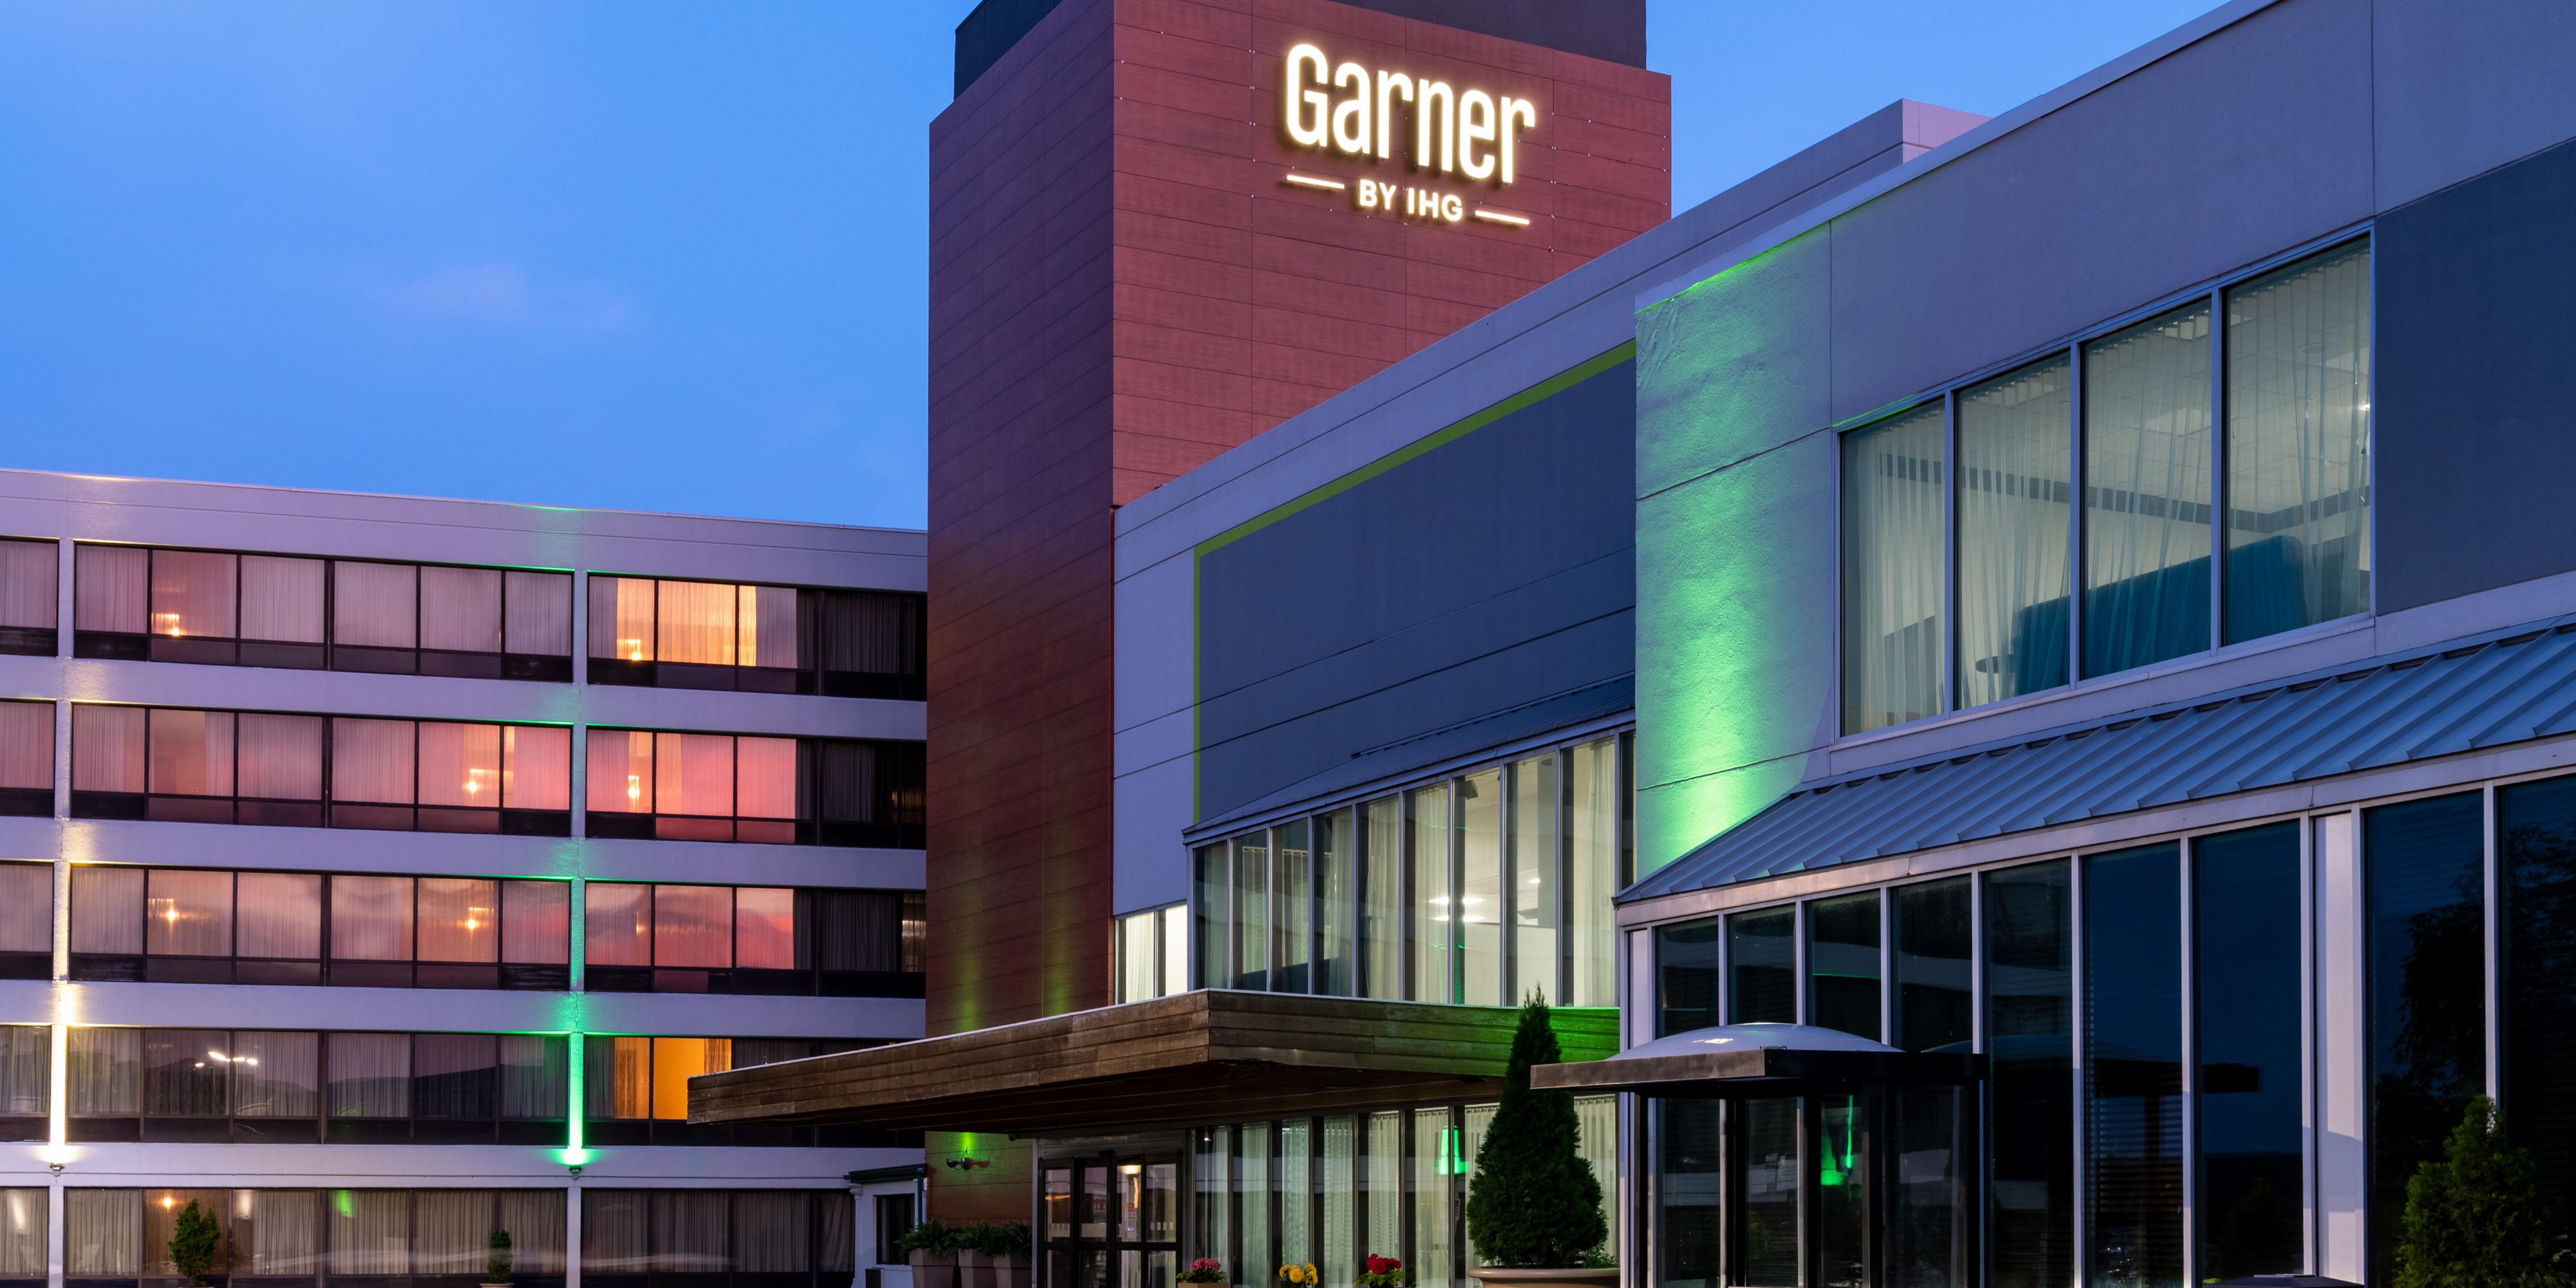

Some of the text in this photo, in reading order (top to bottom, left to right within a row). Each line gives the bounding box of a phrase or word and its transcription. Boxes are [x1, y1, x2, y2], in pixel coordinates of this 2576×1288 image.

[1287, 43, 1535, 184] Garner
[1359, 179, 1463, 222] BY IHG
